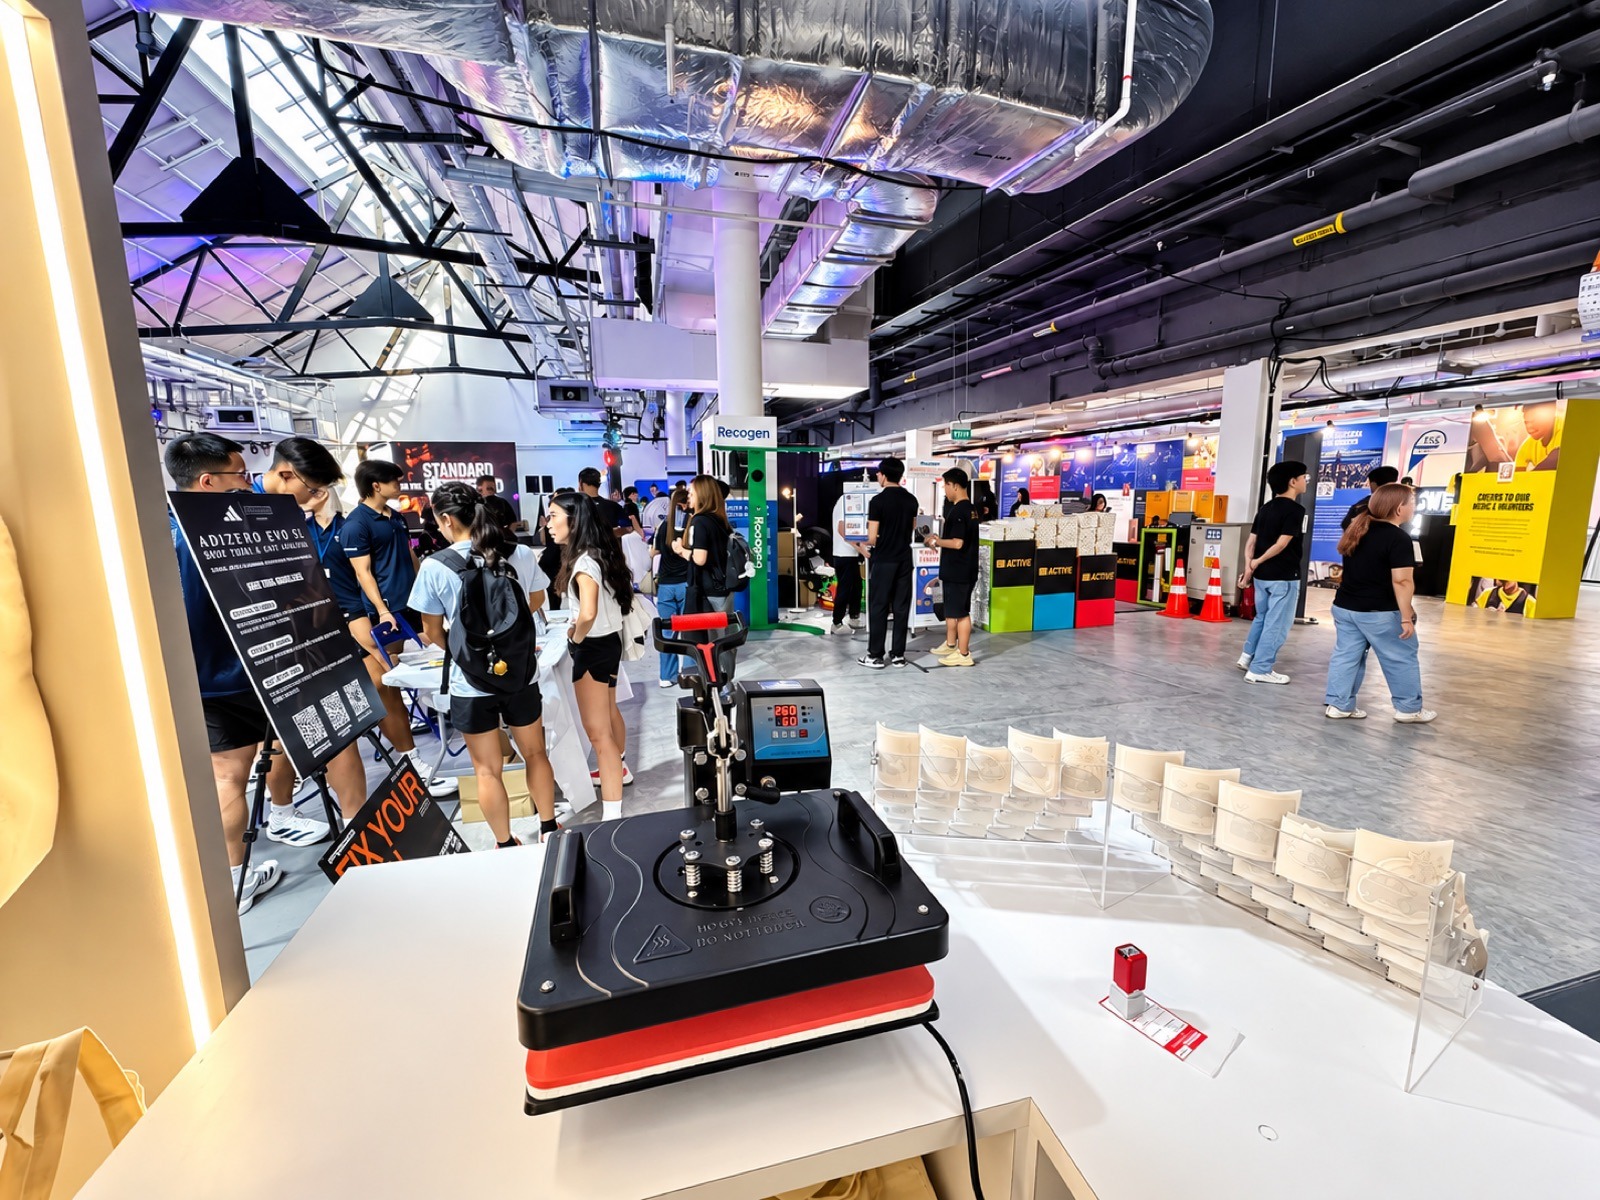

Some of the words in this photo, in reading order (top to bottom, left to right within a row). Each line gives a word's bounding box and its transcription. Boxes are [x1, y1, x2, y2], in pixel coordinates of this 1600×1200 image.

[717, 425, 770, 441] Recogen
[422, 461, 494, 478] STANDARD
[199, 531, 262, 548] ADIZERO
[265, 529, 289, 542] EVO
[291, 528, 305, 539] SL
[1006, 558, 1032, 568] ACTIVE
[1048, 566, 1073, 576] ACTIVE
[1090, 571, 1115, 581] ACTIVE
[775, 705, 797, 716] 260
[366, 770, 425, 847] YOUR
[723, 929, 751, 942] NOT
